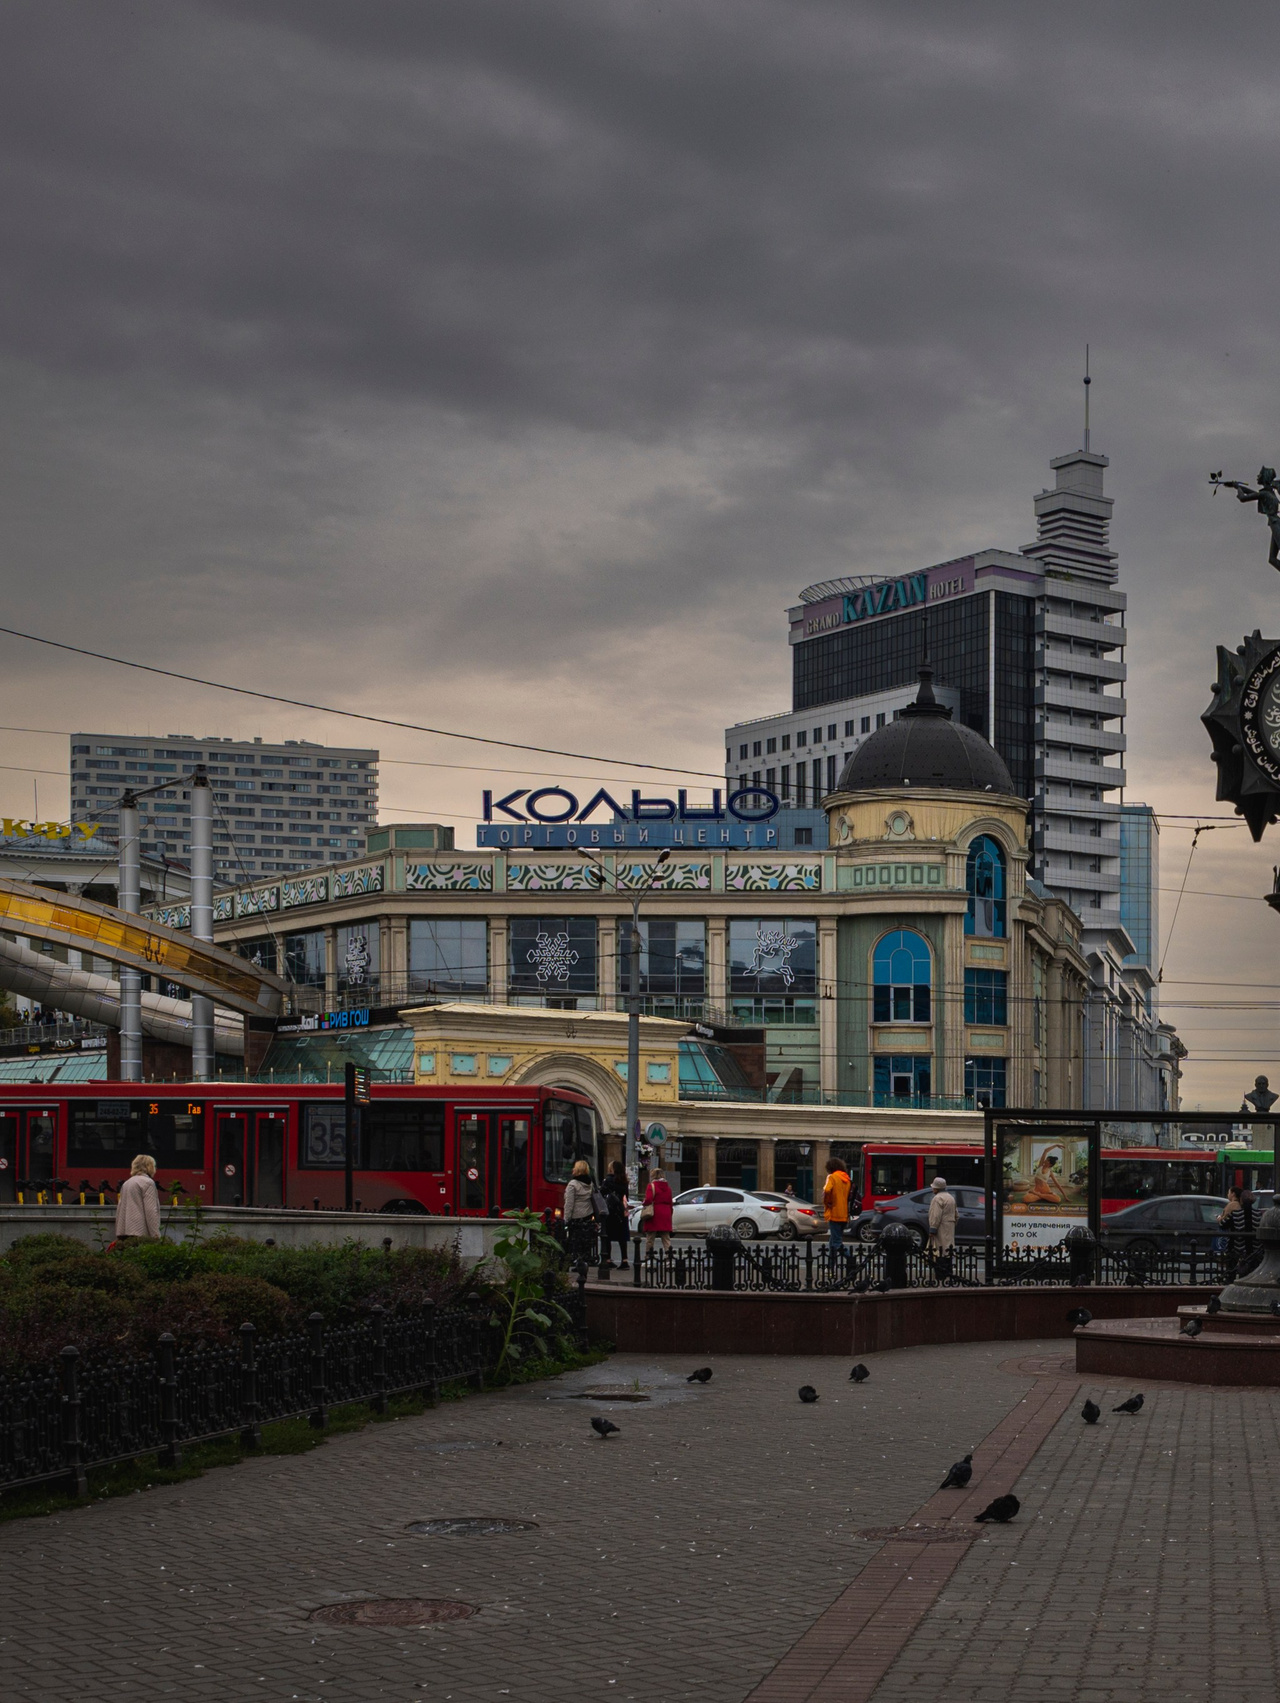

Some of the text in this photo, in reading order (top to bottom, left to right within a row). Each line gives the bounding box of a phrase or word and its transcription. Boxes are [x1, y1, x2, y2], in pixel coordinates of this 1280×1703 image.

[806, 573, 966, 634] GRAND KAZAN HOTEL
[482, 785, 781, 823] КОЛЬЦО
[478, 828, 776, 845] ТОРГОВЫЙ ЦЕНТР
[329, 1008, 370, 1028] РИВ ГОШ
[310, 1122, 347, 1156] 35
[1028, 1222, 1071, 1230] увлечения
